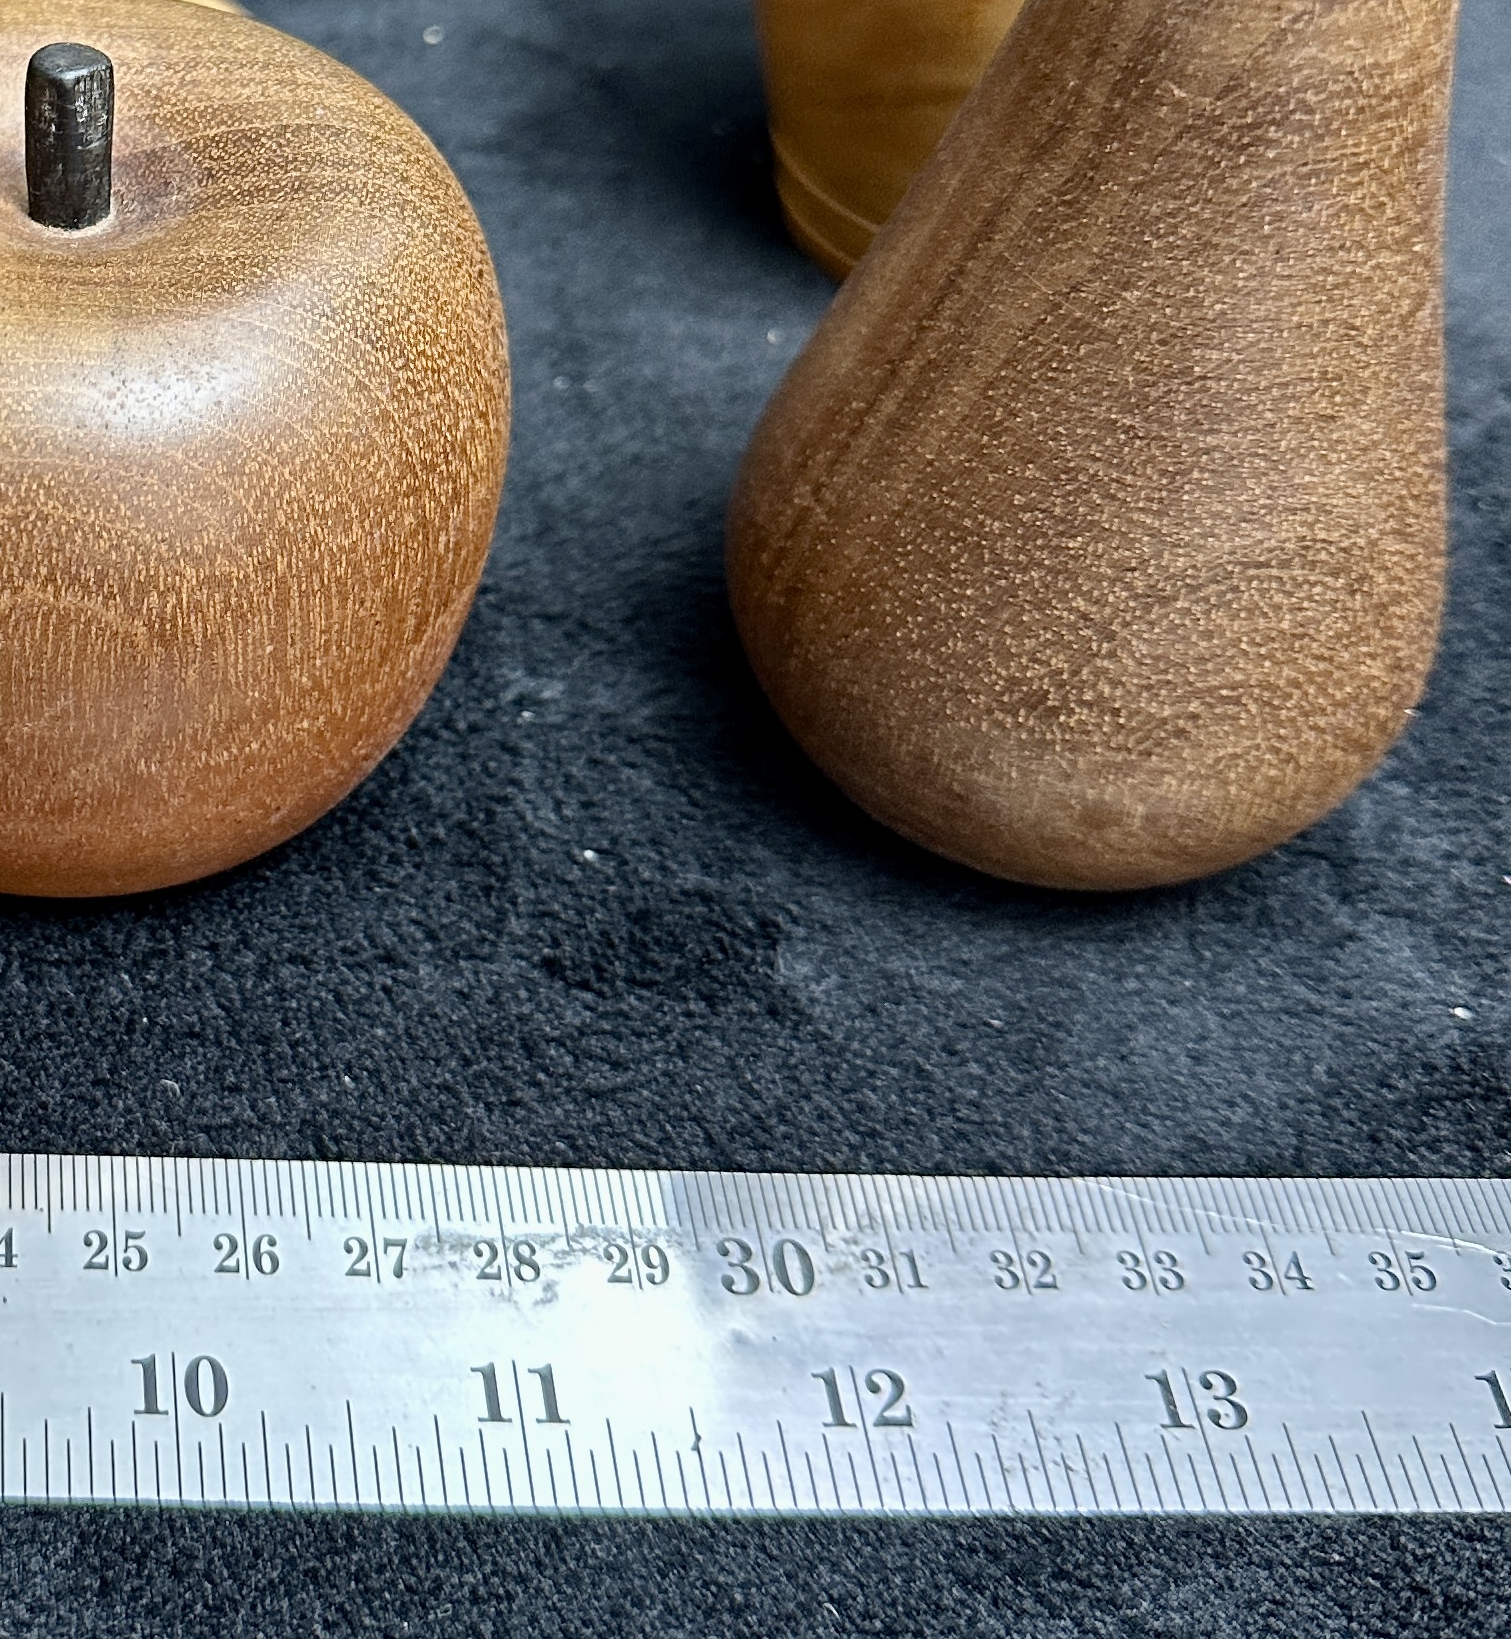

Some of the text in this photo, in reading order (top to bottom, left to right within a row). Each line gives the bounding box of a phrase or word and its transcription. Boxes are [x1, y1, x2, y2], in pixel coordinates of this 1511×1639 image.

[83, 1230, 150, 1272] 25
[214, 1233, 280, 1276] 26
[344, 1236, 408, 1279] 27
[474, 1239, 541, 1282] 28
[603, 1242, 670, 1285] 29
[716, 1237, 816, 1297] 30
[860, 1248, 928, 1290] 31
[990, 1249, 1059, 1291] 32
[1116, 1250, 1186, 1292] 33
[1242, 1250, 1315, 1292] 34
[1368, 1250, 1437, 1292] 35
[130, 1352, 230, 1418] 10
[469, 1361, 571, 1425] 11
[811, 1367, 914, 1429] 12
[1144, 1368, 1250, 1431] 13
